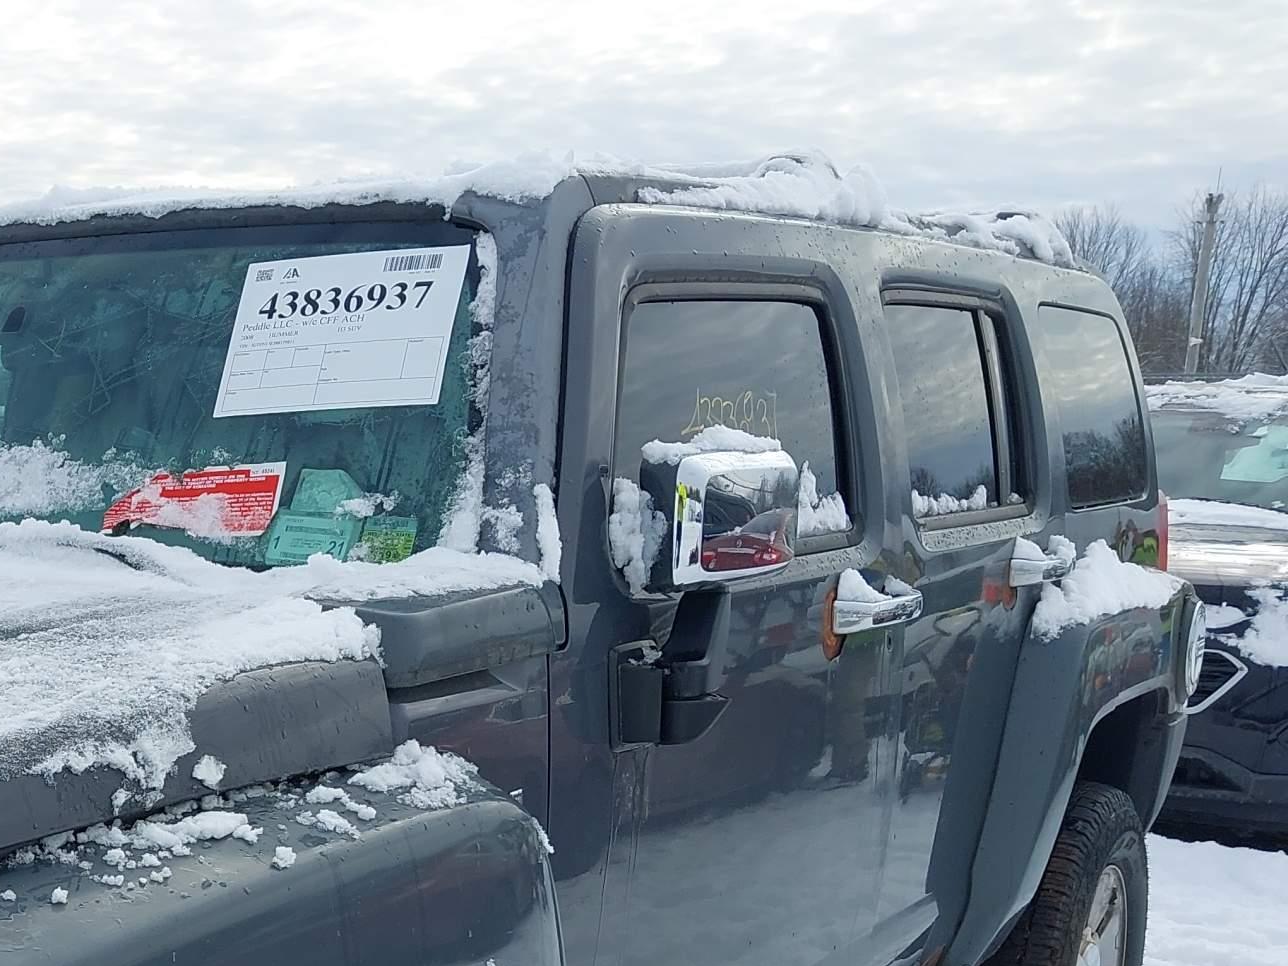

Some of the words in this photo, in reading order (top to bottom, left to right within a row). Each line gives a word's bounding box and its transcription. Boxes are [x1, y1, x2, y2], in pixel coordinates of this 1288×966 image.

[259, 281, 434, 320] 43836937
[242, 321, 271, 332] Peddle
[273, 319, 293, 329] LLC
[341, 314, 365, 323] ACH
